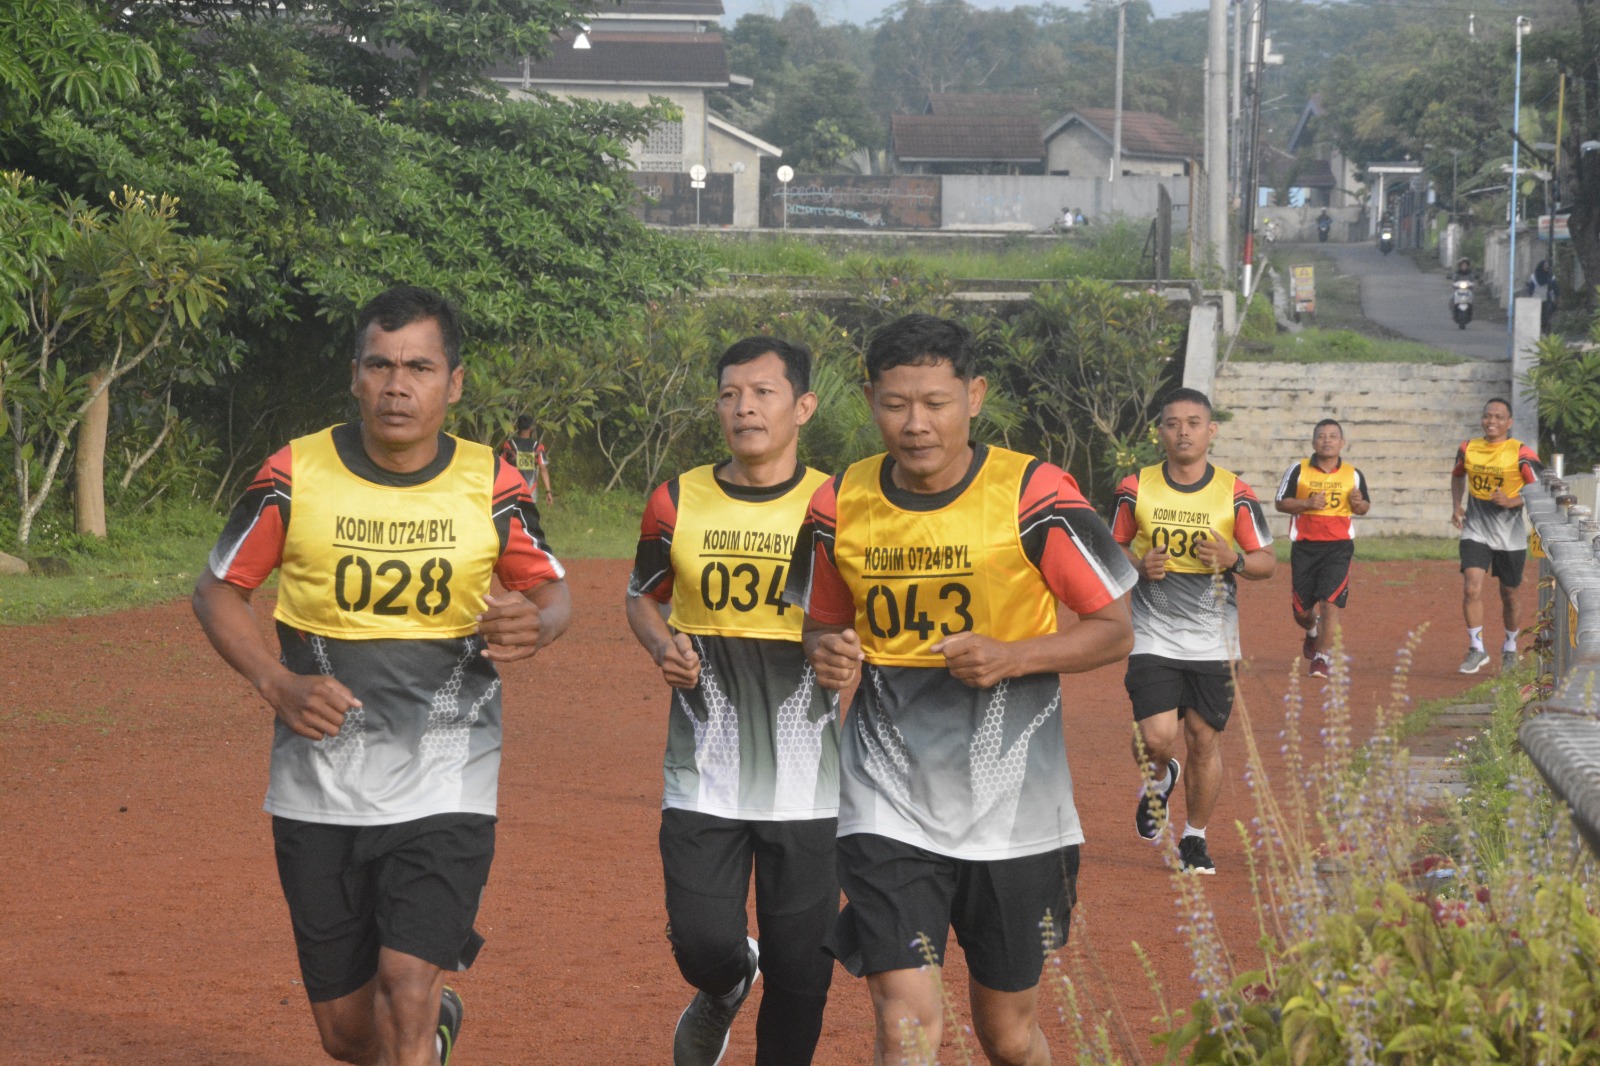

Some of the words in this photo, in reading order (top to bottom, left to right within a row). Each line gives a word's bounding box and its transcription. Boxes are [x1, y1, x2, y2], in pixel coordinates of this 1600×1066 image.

[1473, 474, 1504, 492] 047
[335, 515, 384, 545] KODIM
[389, 518, 457, 545] 0724/BYL
[1153, 508, 1176, 521] KODIM
[1178, 511, 1211, 525] 0724/BYL
[703, 529, 741, 550] KODIM
[743, 532, 795, 556] 0724/BYL
[1152, 526, 1208, 559] 038
[864, 546, 904, 571] KODIM
[908, 545, 972, 570] 0724/BYL
[335, 554, 453, 616] 028
[700, 561, 791, 616] 034
[866, 582, 974, 641] 043
